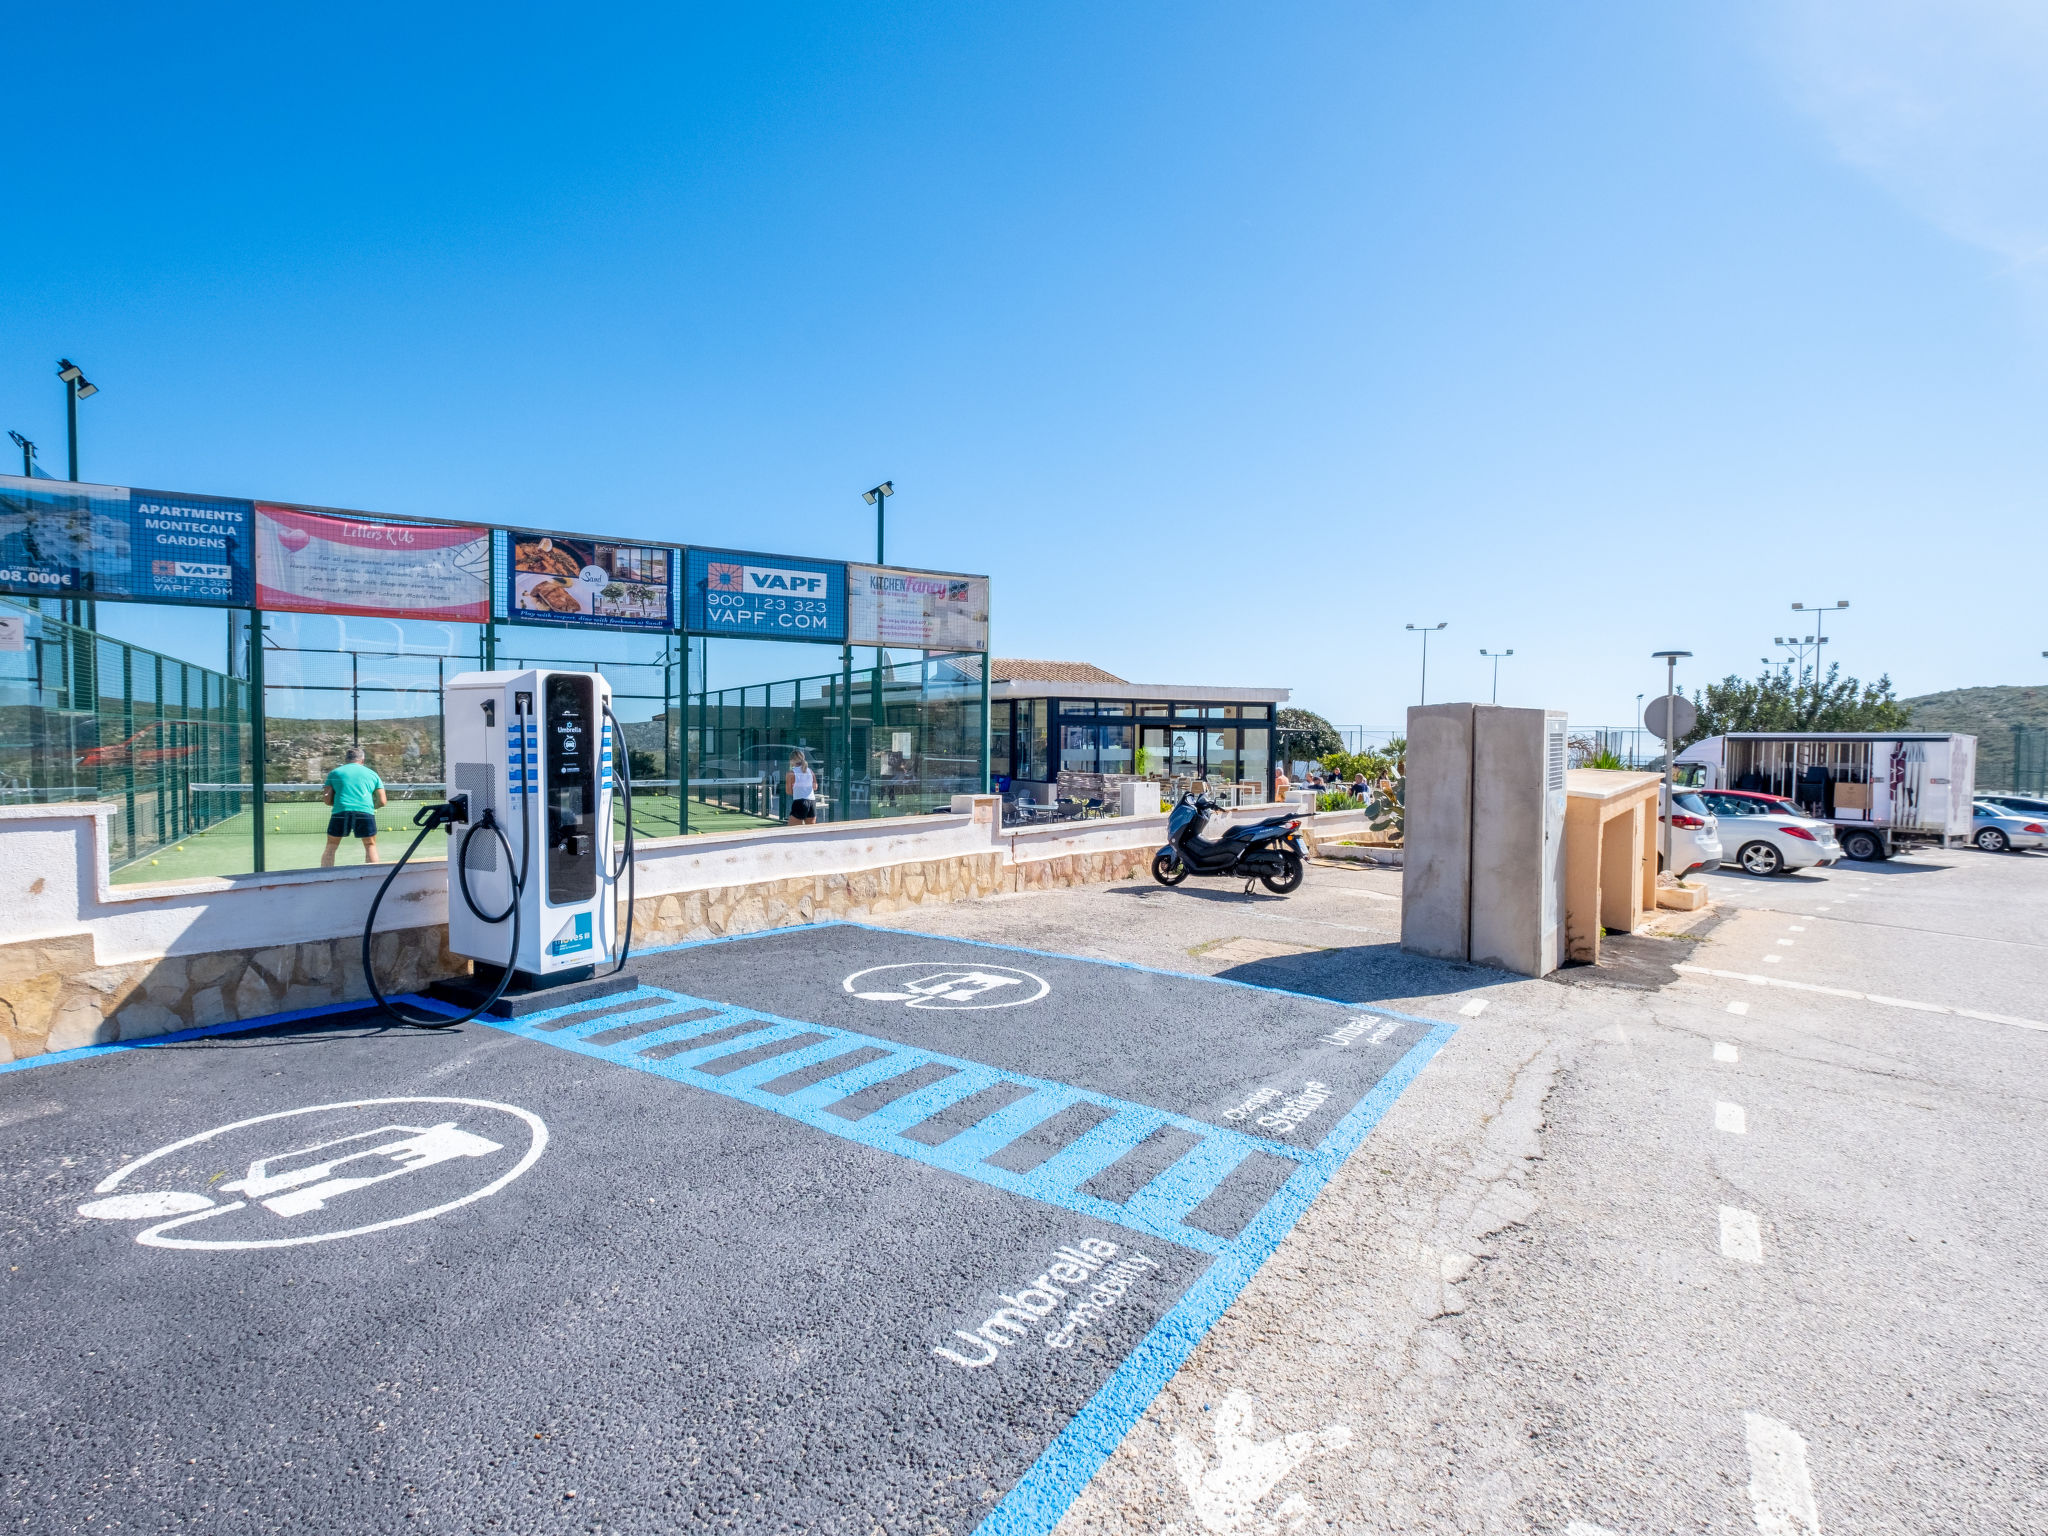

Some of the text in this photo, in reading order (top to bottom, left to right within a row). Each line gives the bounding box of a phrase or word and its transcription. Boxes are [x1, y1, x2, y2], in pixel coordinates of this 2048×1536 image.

[138, 503, 243, 522] APARTMENTS
[145, 518, 237, 536] MONTECALA
[343, 523, 415, 546] Letters R Us
[156, 533, 227, 549] GARDENS
[180, 565, 228, 576] VAPF
[581, 571, 602, 582] Sand
[750, 573, 821, 592] VAPF
[707, 593, 744, 607] 900
[793, 600, 827, 613] 323
[708, 607, 827, 629] VAPF.COM
[933, 1238, 1119, 1367] Umbrella
